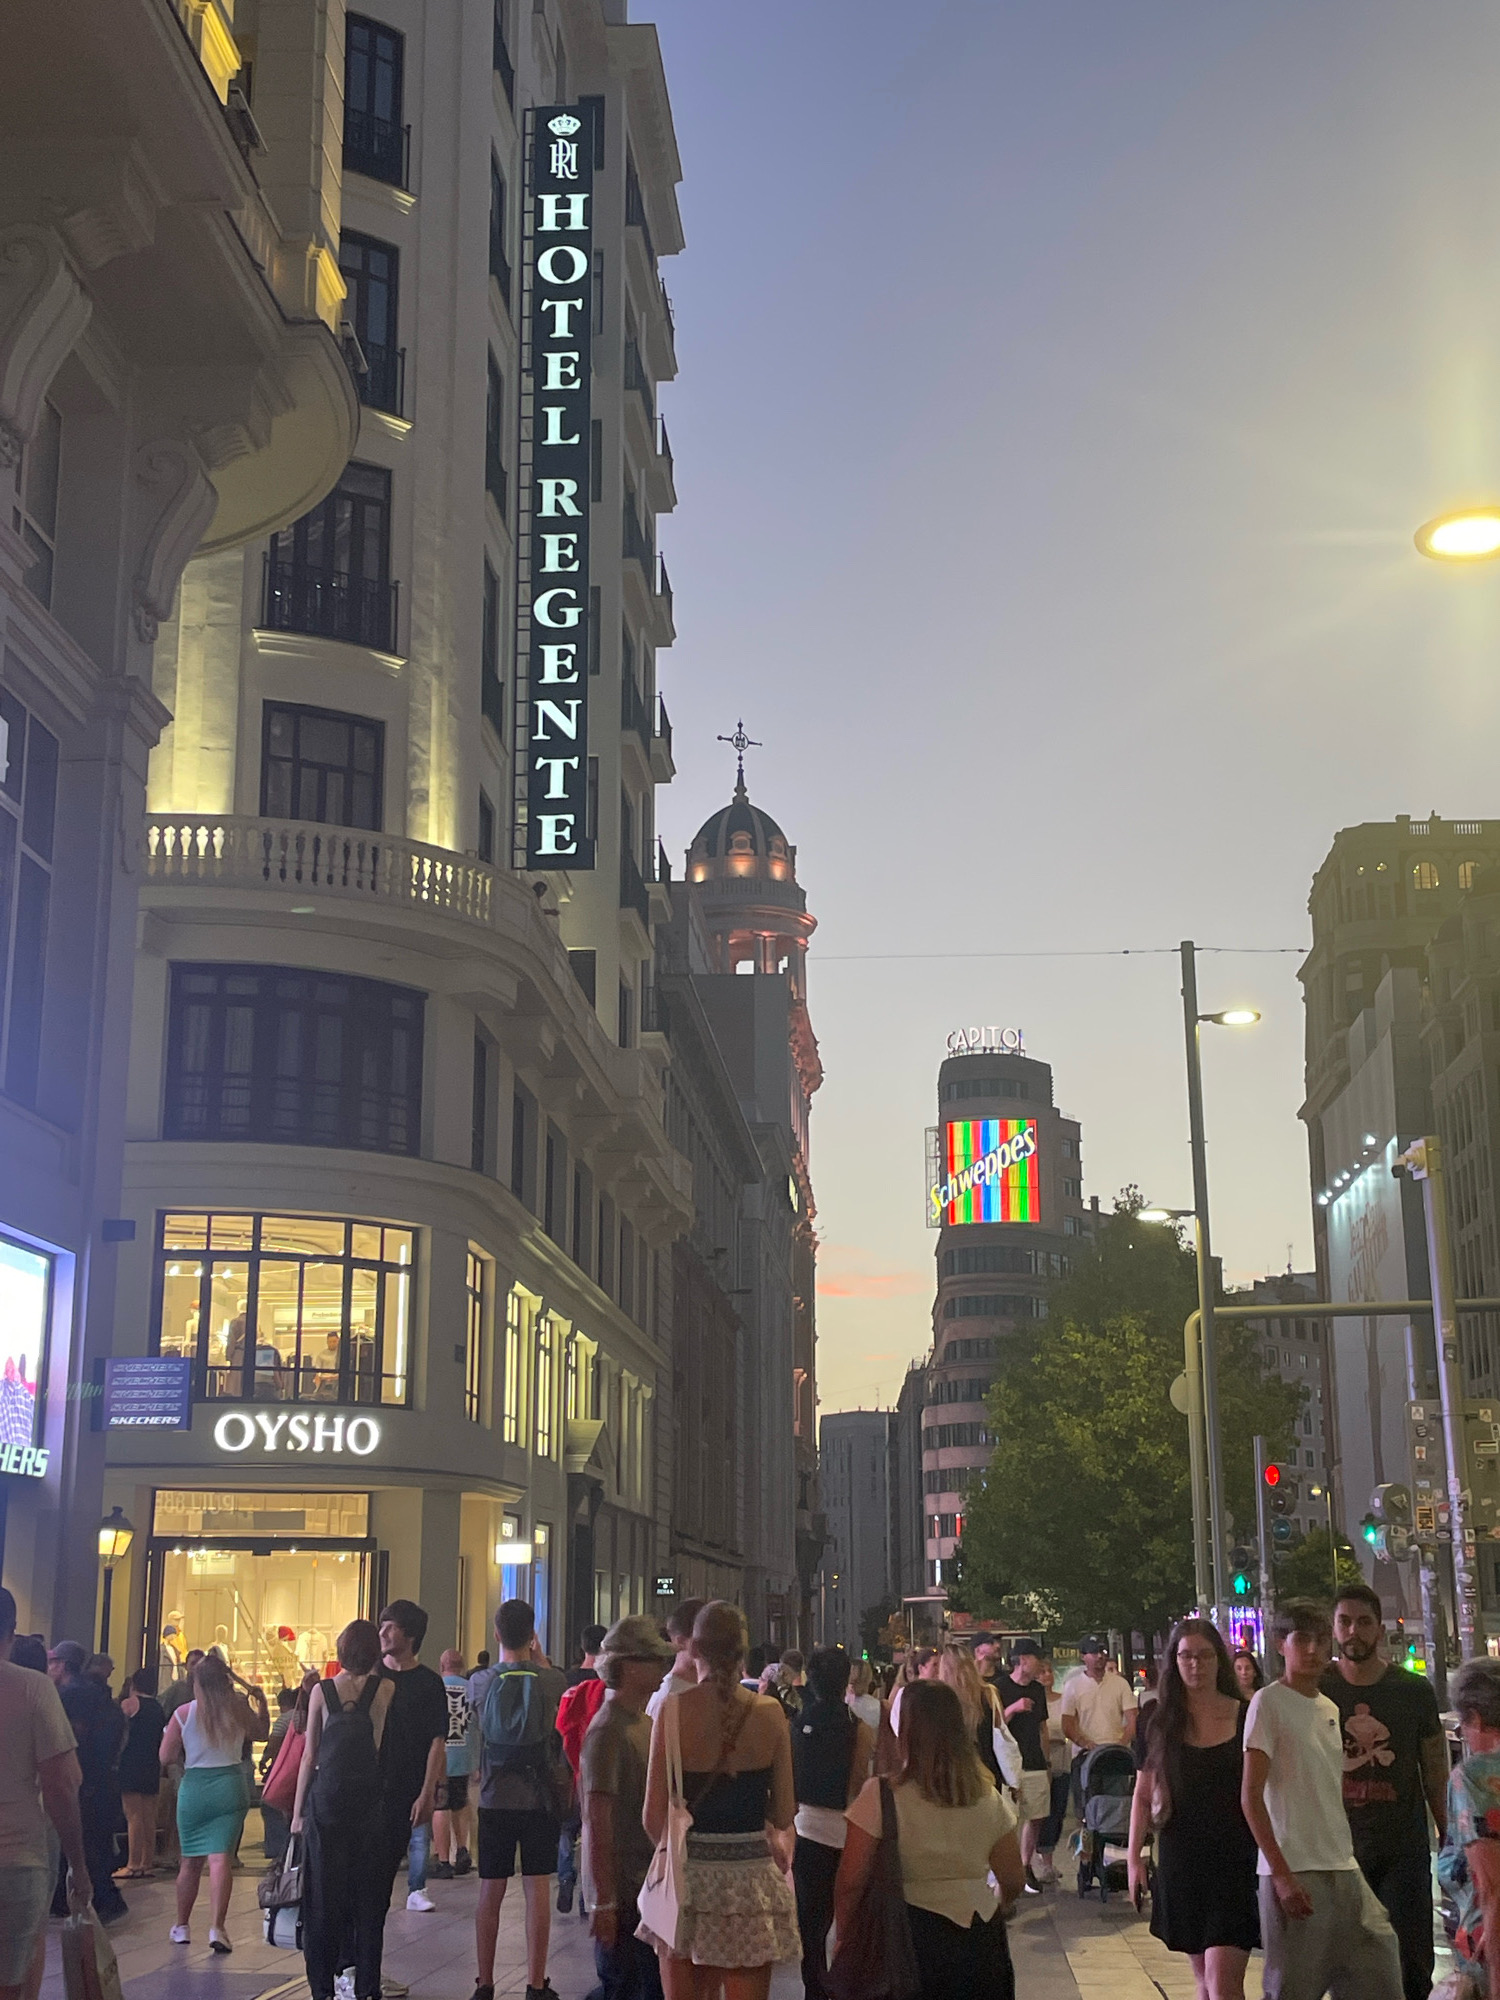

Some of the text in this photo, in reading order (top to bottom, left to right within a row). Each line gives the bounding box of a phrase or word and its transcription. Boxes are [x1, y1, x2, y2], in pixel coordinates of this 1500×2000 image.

[532, 193, 589, 855] HOTEL REGENTE
[946, 1026, 1026, 1051] CAPITOL
[930, 1126, 1036, 1219] Schweppes
[108, 1415, 182, 1425] SKECHERS
[213, 1412, 381, 1456] OYSHO
